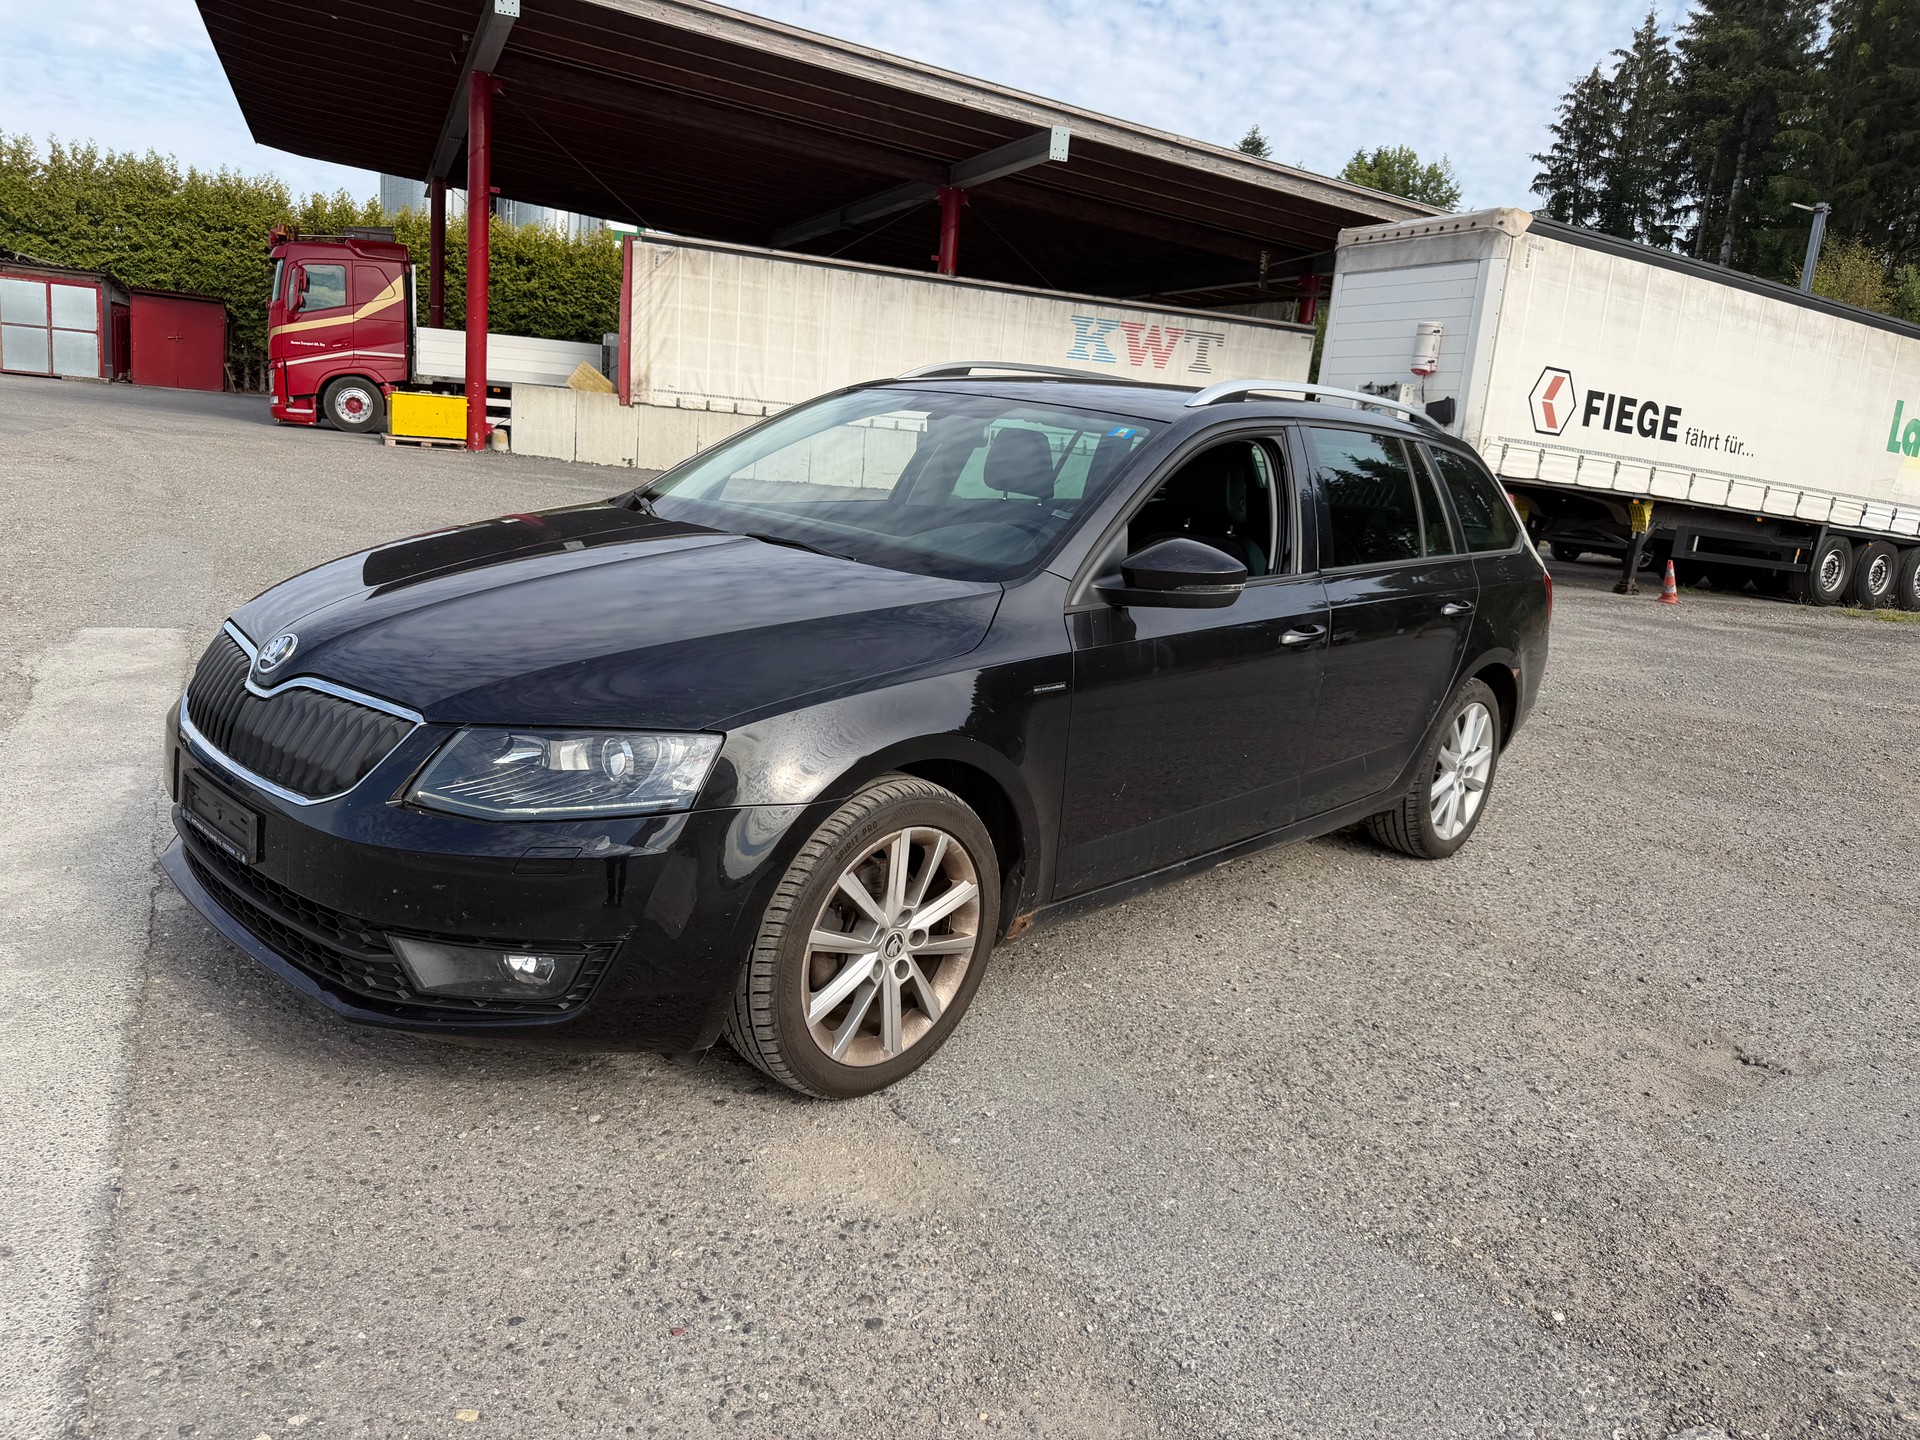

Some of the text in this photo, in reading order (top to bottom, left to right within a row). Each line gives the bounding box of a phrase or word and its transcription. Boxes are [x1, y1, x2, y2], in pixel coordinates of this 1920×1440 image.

[1066, 315, 1225, 374] KWT
[1582, 389, 1754, 457] FIEGE fährt für...
[835, 821, 878, 863] SPIRIT PRO
